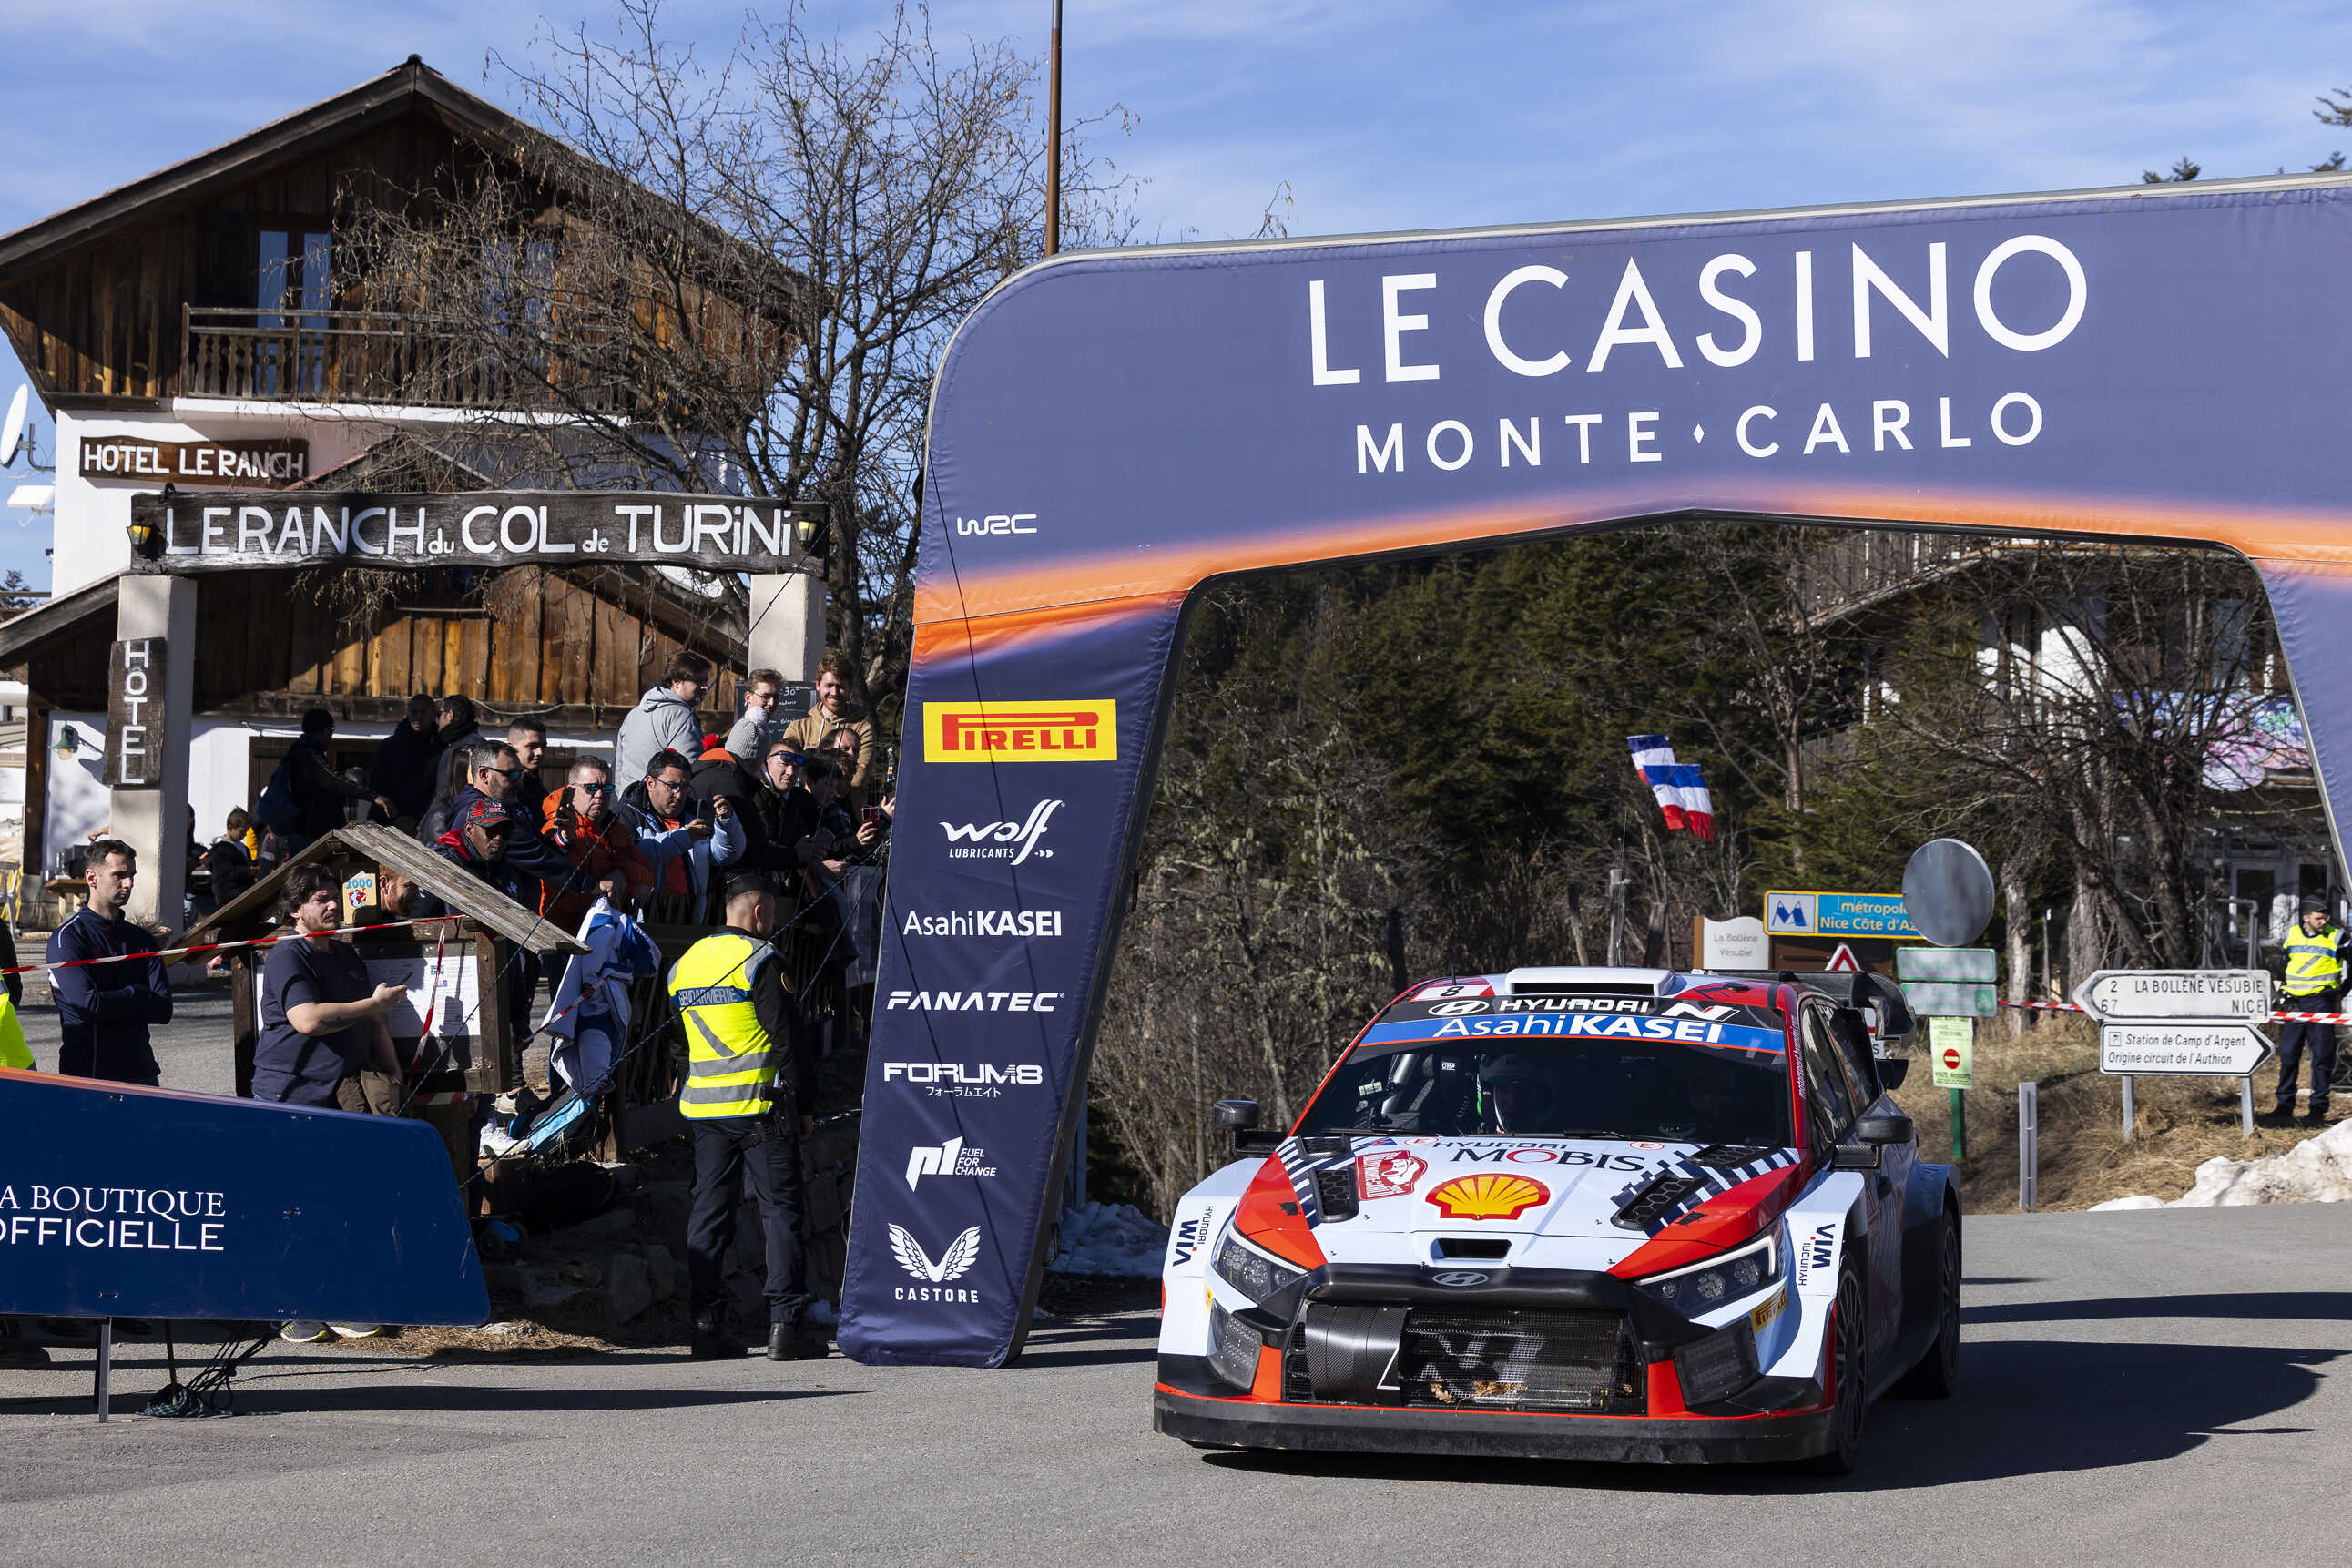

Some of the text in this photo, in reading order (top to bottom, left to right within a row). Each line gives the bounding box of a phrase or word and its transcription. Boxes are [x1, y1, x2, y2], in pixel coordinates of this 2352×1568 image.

[1309, 234, 2088, 387] LE CASINO
[1356, 391, 2042, 473] MONTE CARLO
[84, 444, 170, 473] HOTEL
[428, 528, 454, 555] du
[461, 505, 575, 554] COL
[582, 528, 609, 553] de
[957, 514, 1038, 536] WRC
[121, 640, 149, 784] HOTEL
[942, 711, 1099, 751] PIRELLI
[949, 848, 1015, 859] LUBRICANTS
[903, 911, 1062, 936] AsahiKASEI
[1820, 916, 1849, 930] Nice
[1852, 917, 1883, 932] Côte
[1441, 986, 1464, 996] 8
[2111, 980, 2118, 993] 2
[2134, 980, 2149, 993] LA
[1501, 997, 1650, 1013] HYUNDAI
[2101, 999, 2264, 1013] 67 NICE
[1432, 1015, 1724, 1044] AsahiKASEI
[2125, 1034, 2159, 1046] Station
[2162, 1034, 2173, 1046] de
[2175, 1034, 2202, 1048] Camp
[2108, 1052, 2141, 1065] Origine
[2143, 1053, 2174, 1064] circuit
[2176, 1053, 2187, 1064] de
[883, 1062, 1043, 1084] FORUM8
[925, 1086, 1002, 1098] フォーラムエイト
[960, 1148, 985, 1157] FUEL
[1433, 1141, 1569, 1149] HYUNDAI
[954, 1166, 997, 1176] CHANGE
[957, 1157, 979, 1166] FOR
[1450, 1148, 1645, 1172] MOBIS
[0, 1185, 226, 1222] A BOUTIQUE
[0, 1217, 225, 1251] FFICIELLE
[1197, 1206, 1214, 1245] HYUNDAI
[1798, 1242, 1811, 1286] HYUNDAI
[895, 1287, 979, 1304] CASTORE
